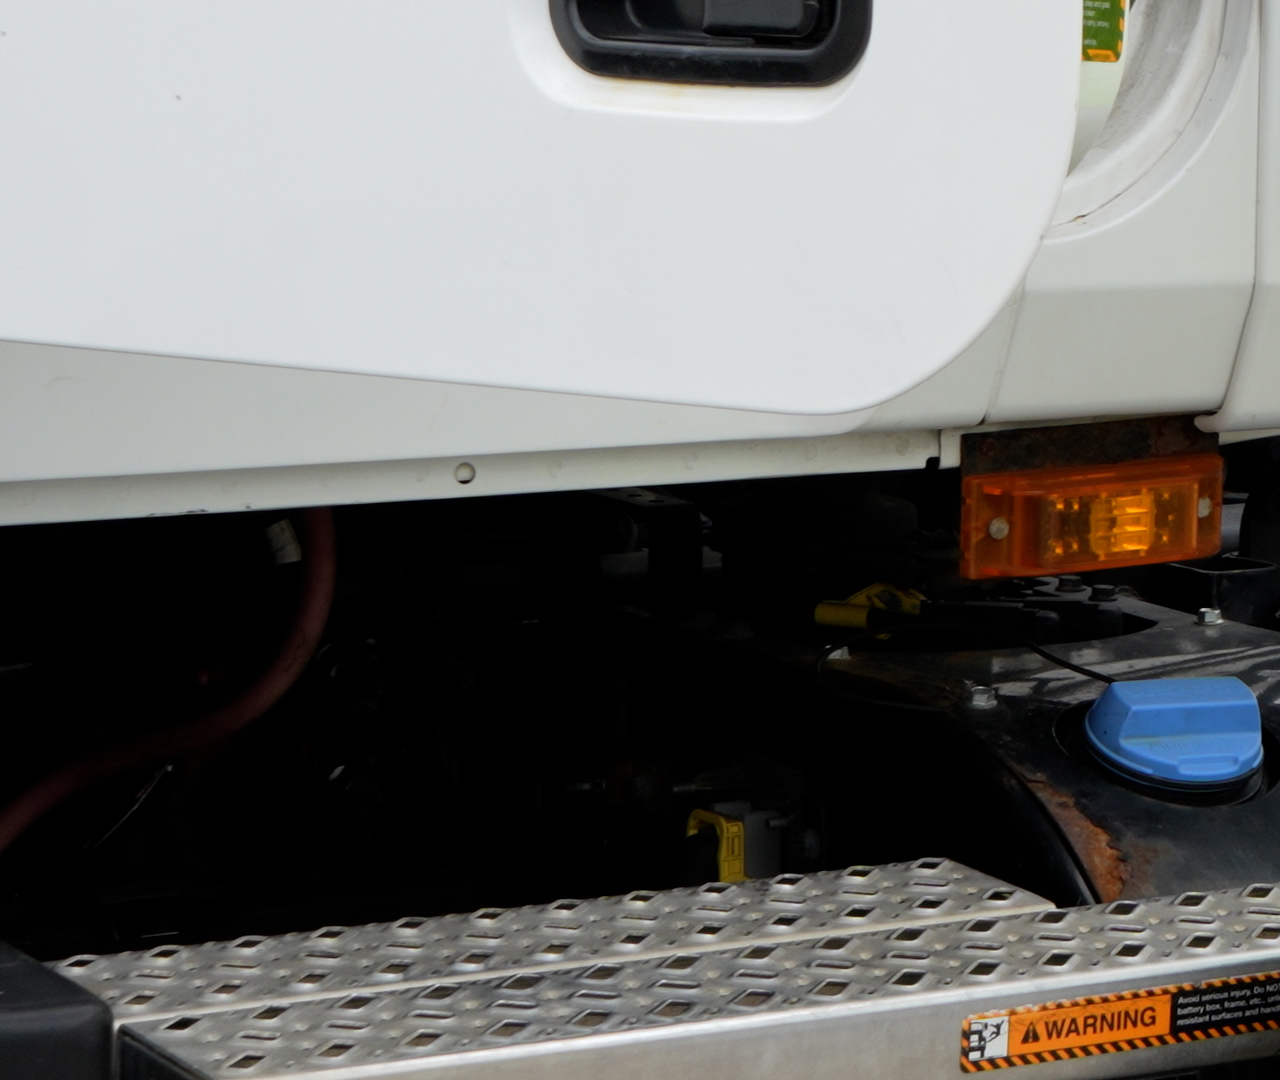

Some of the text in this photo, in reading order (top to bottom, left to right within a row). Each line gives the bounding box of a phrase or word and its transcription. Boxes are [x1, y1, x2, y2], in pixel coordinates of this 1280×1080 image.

[1177, 994, 1200, 1005] Avoid
[1201, 991, 1229, 1002] serious
[1253, 985, 1264, 995] Do
[1176, 1015, 1210, 1026] resistant
[1211, 1010, 1243, 1021] surfaces
[1244, 1007, 1259, 1016] and
[1177, 1005, 1205, 1016] battery
[1044, 1006, 1157, 1041] WARNING
